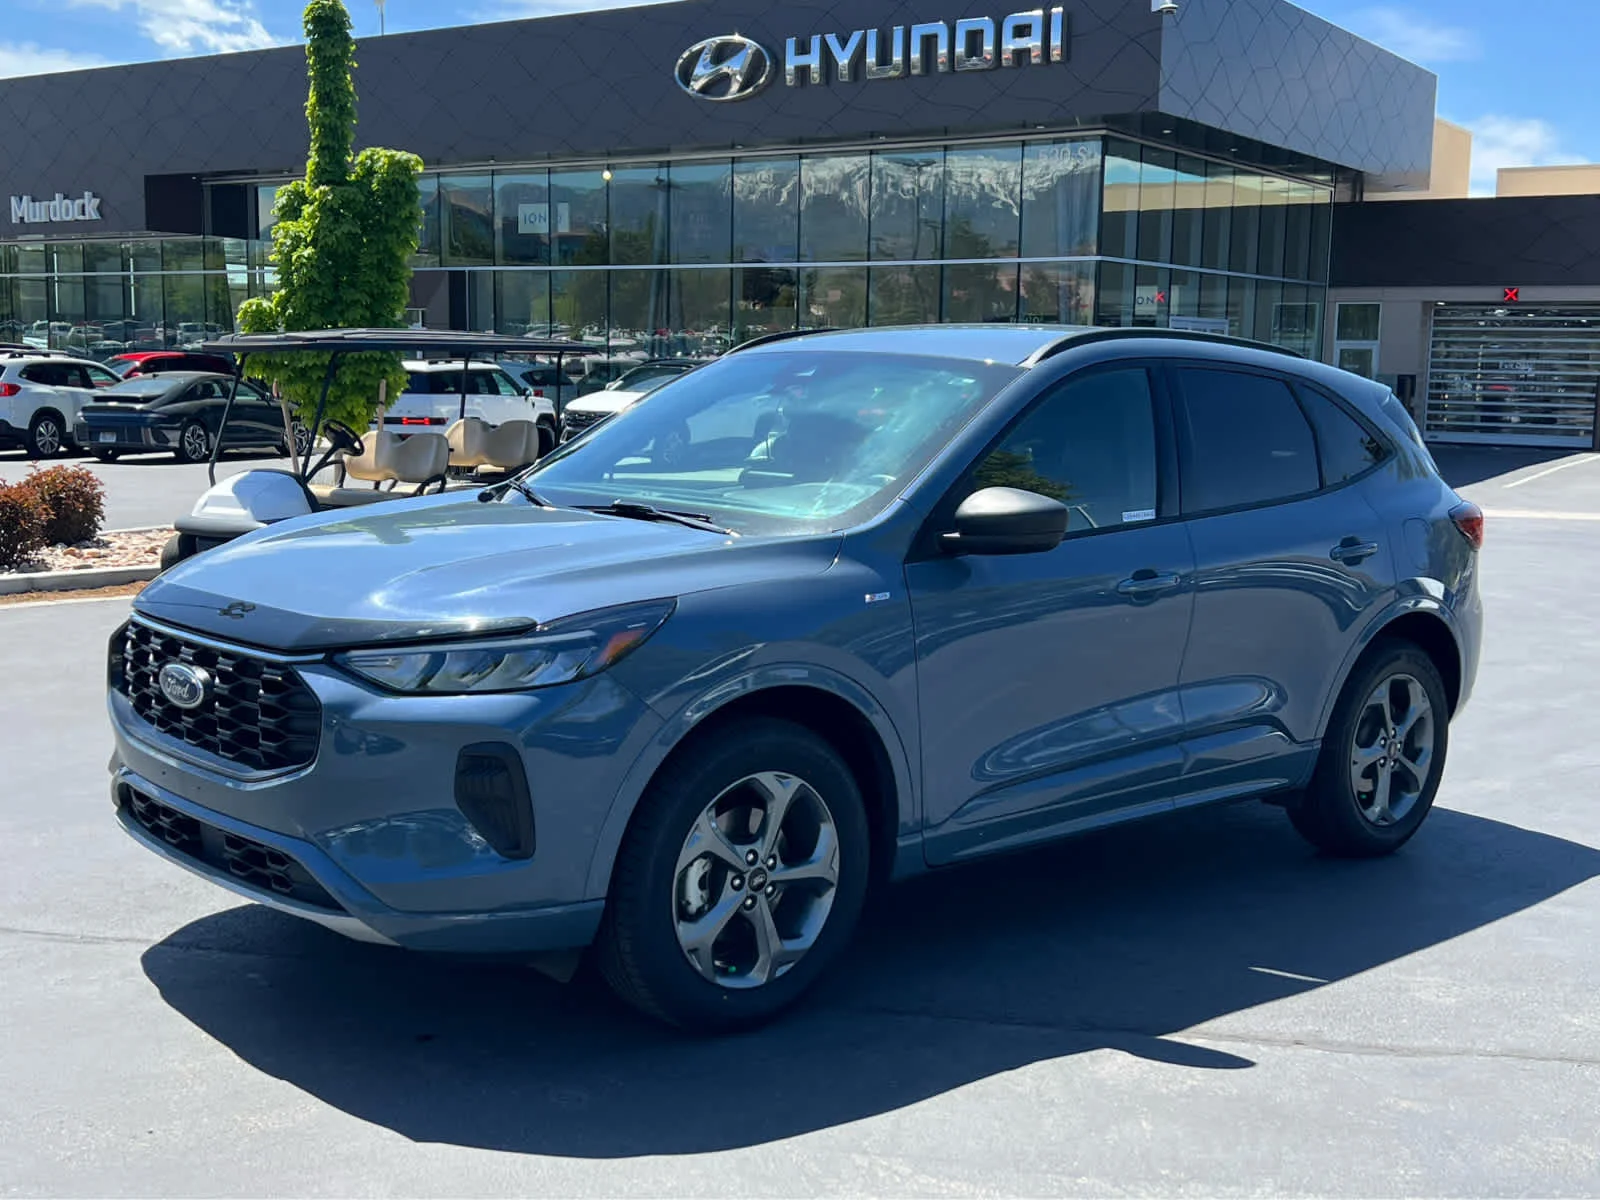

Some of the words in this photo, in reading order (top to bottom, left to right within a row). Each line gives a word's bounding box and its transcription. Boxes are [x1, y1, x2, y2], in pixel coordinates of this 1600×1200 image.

[785, 6, 1065, 86] HYUNDAI
[10, 191, 101, 223] Murdock
[165, 677, 190, 699] Ford
